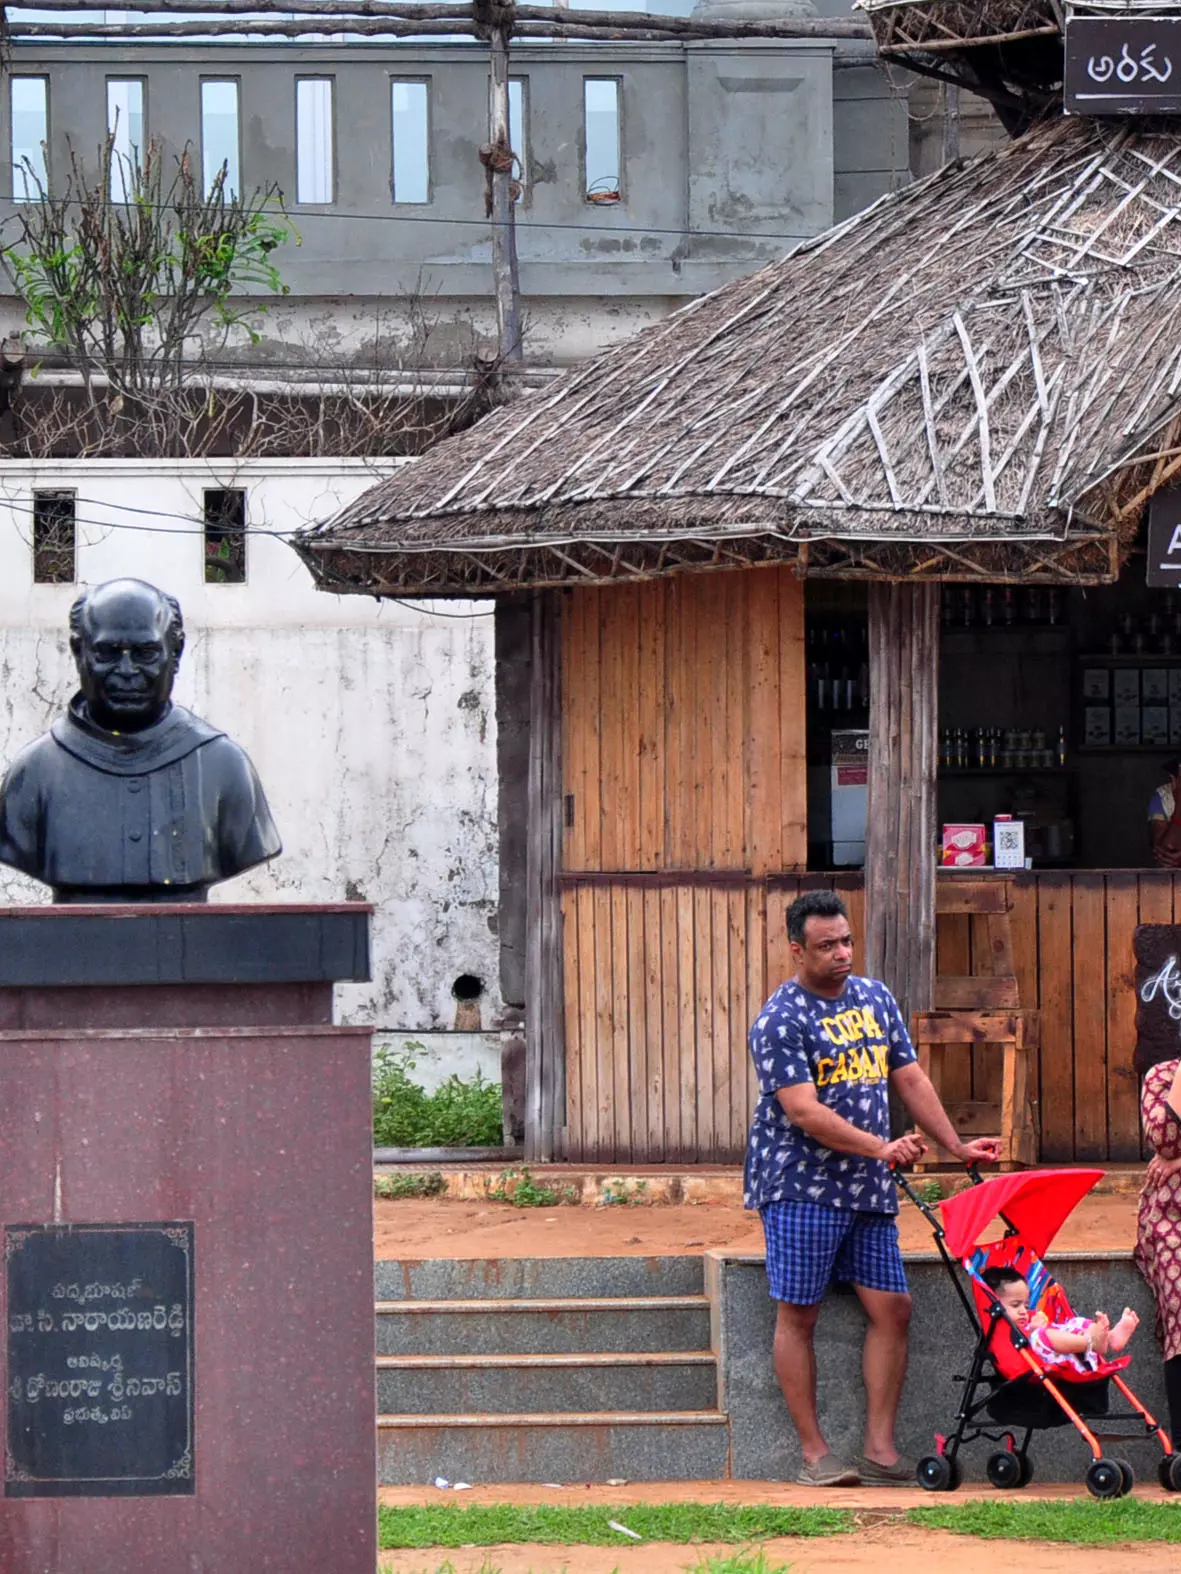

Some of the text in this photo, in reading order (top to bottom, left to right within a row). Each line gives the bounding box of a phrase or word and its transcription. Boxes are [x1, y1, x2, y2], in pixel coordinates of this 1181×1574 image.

[1087, 43, 1173, 82] అరకు
[821, 1006, 884, 1045] COPA
[817, 1044, 889, 1086] CABAN
